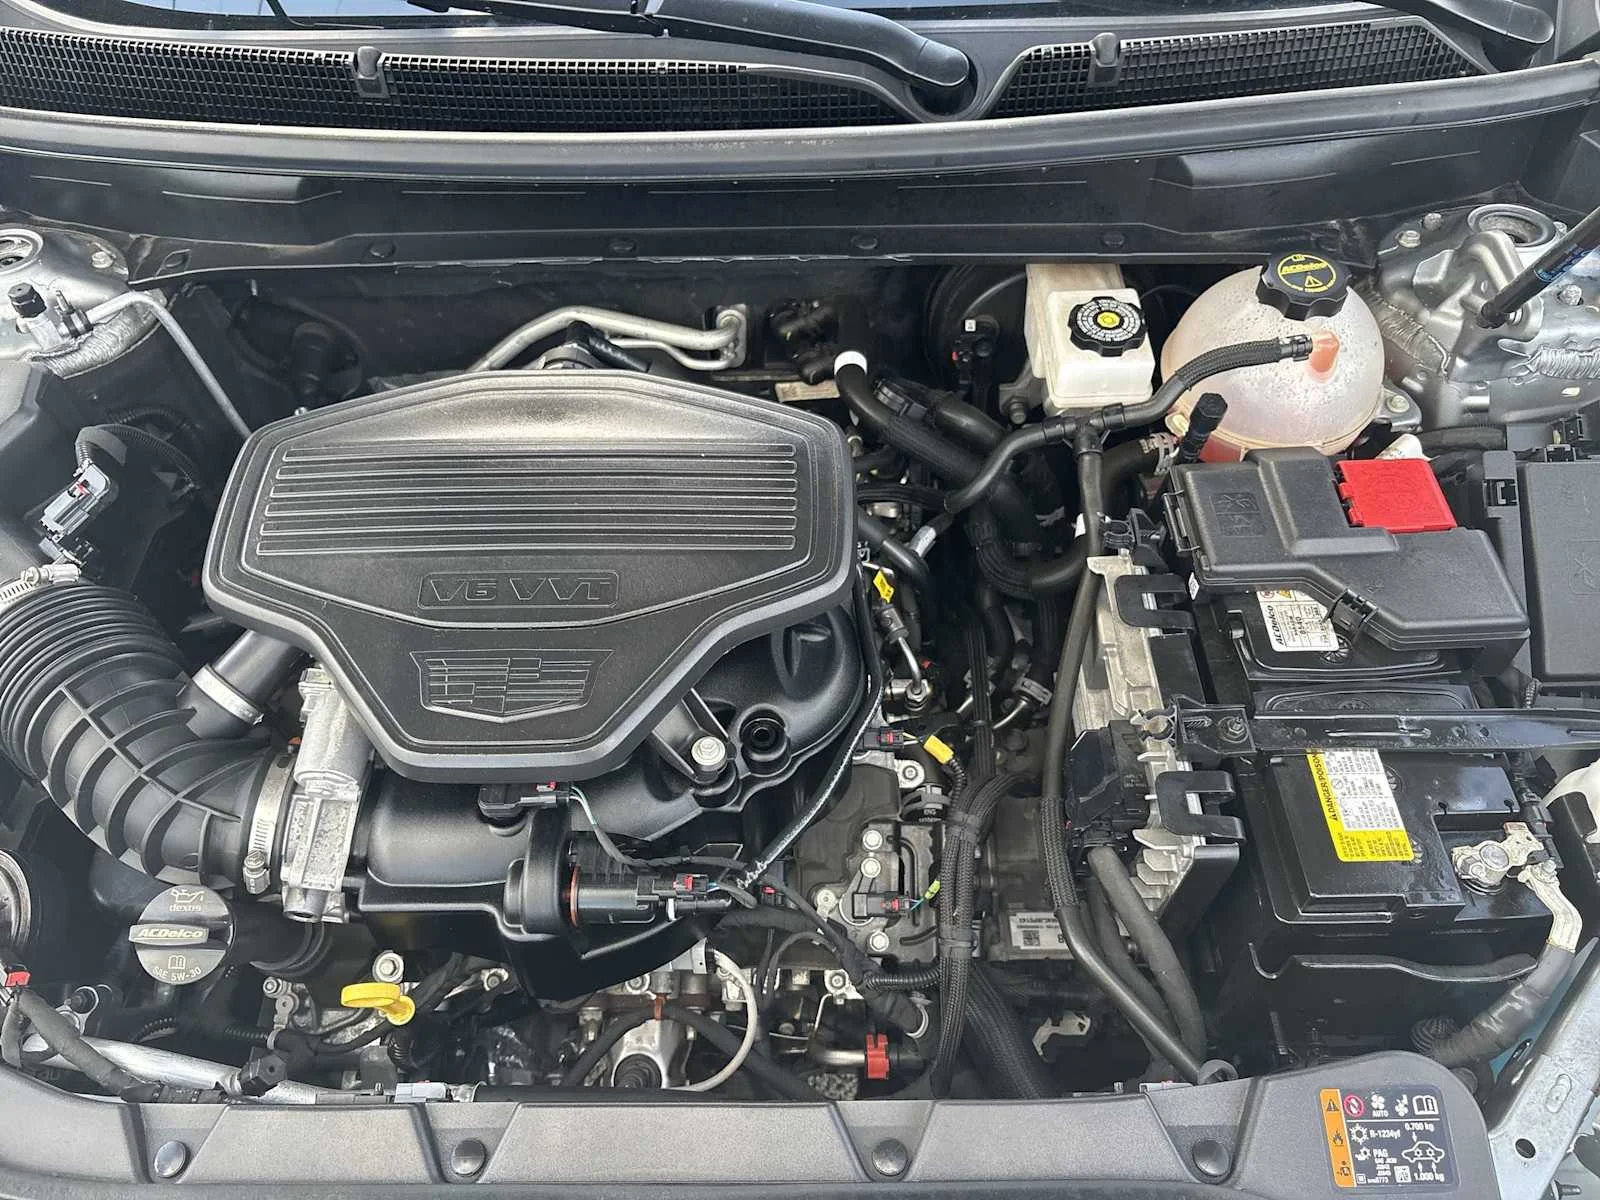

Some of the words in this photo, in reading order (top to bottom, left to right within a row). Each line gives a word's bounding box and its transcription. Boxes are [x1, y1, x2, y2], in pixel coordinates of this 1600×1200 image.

[430, 578, 498, 601] V6
[509, 578, 611, 600] VVT
[1266, 605, 1284, 645] ACDelco
[138, 929, 203, 938] ACDelco
[153, 966, 168, 979] SAE
[171, 966, 202, 981] 5W-30
[1372, 1110, 1389, 1118] AUTO
[1373, 1149, 1389, 1158] PAG
